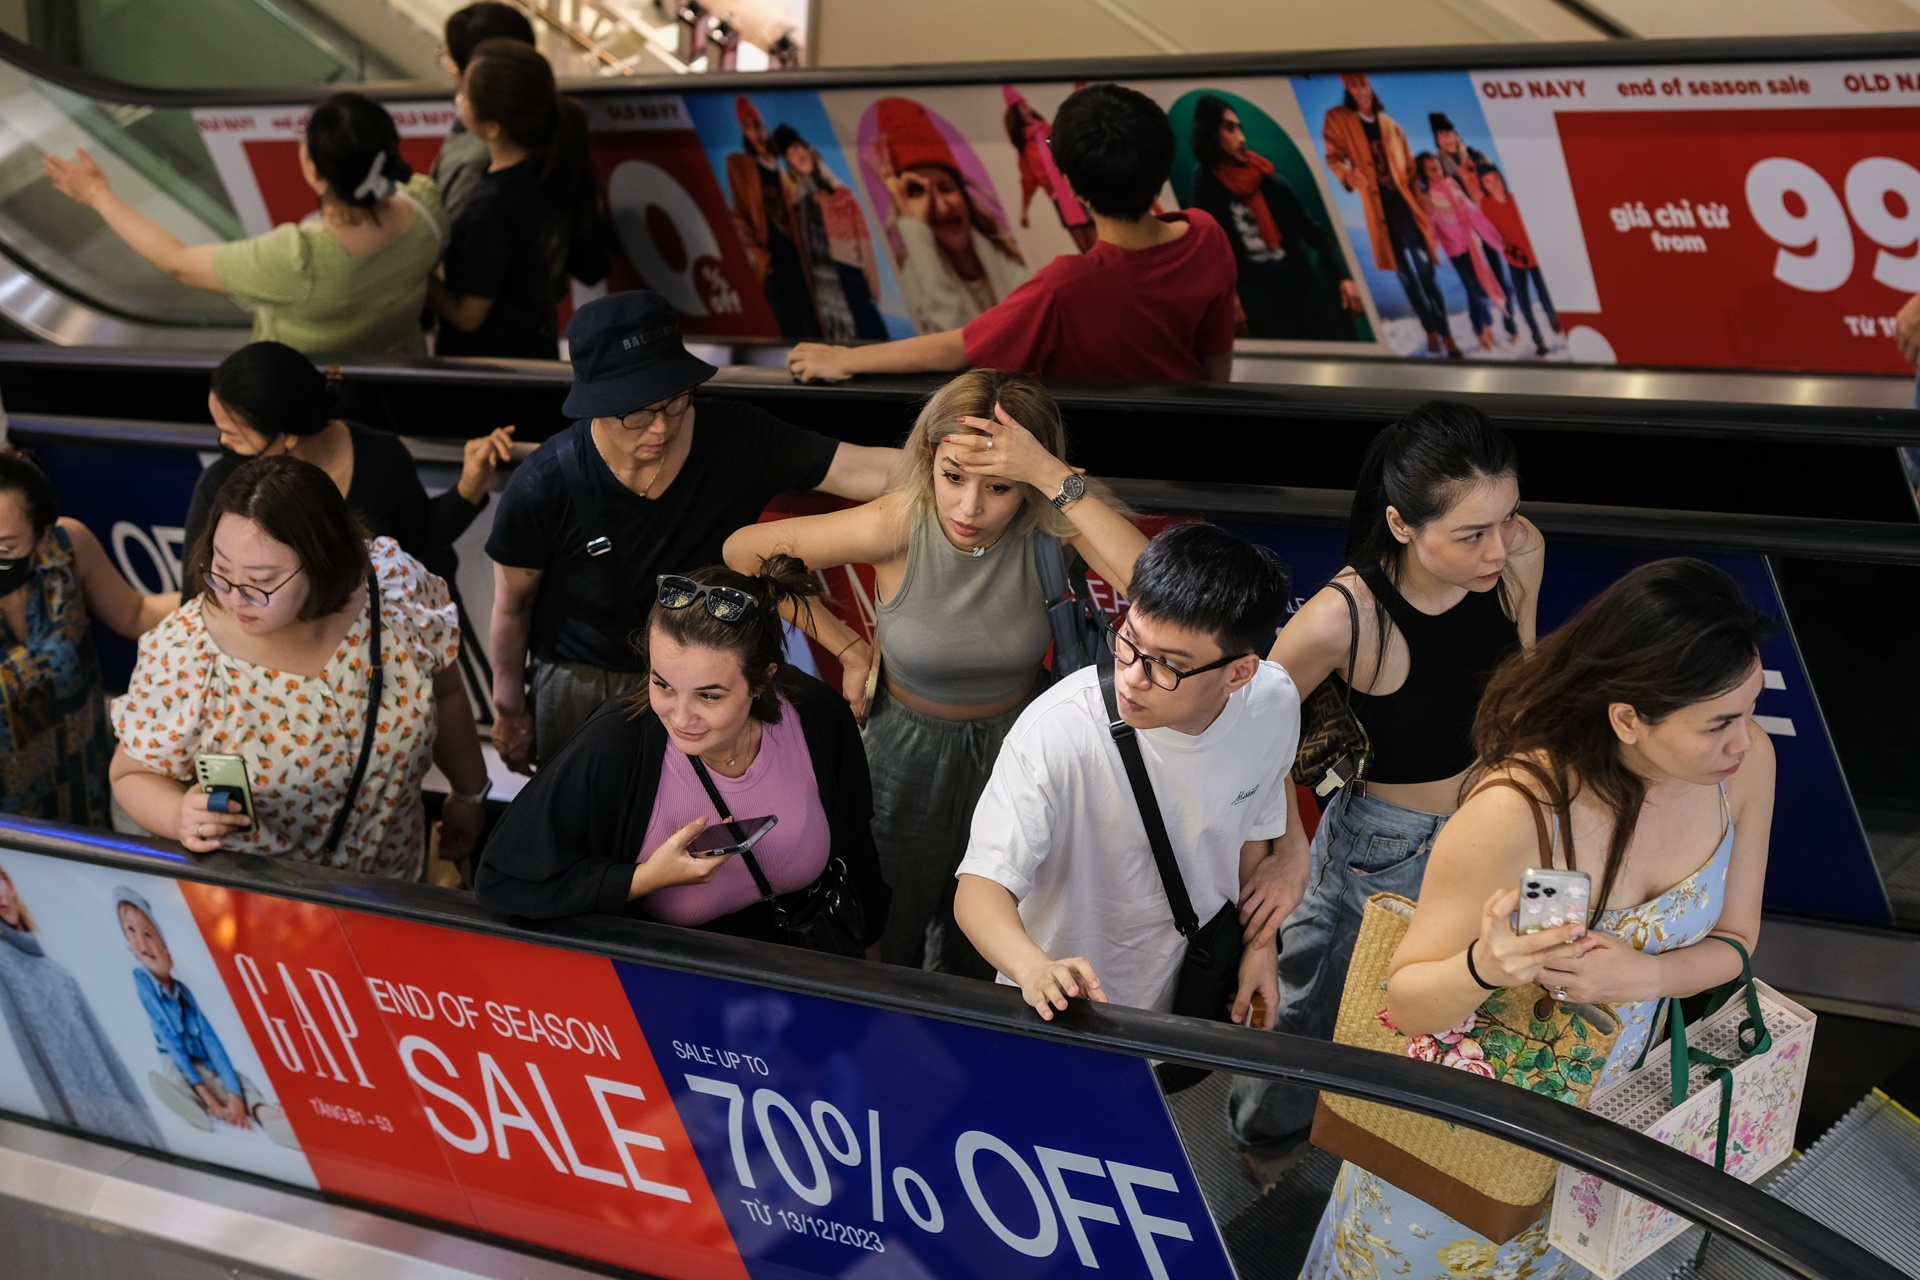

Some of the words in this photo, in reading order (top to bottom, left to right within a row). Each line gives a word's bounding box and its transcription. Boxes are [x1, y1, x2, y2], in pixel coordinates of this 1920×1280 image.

[1482, 80, 1524, 99] OLD
[1527, 80, 1586, 98] NAVY
[1618, 76, 1656, 96] end
[1661, 77, 1682, 95] of
[1686, 79, 1763, 96] season
[1767, 74, 1811, 95] sale
[1843, 73, 1892, 93] OLD
[1609, 201, 1653, 232] giá
[1744, 156, 1920, 294] 99
[1650, 230, 1708, 253] from
[234, 953, 376, 1089] GAP
[366, 976, 435, 1020] END
[437, 991, 479, 1030] OF
[485, 1000, 621, 1061] SEASON
[672, 1040, 718, 1066] SALE
[715, 1048, 741, 1070] UP
[741, 1054, 770, 1077] TO
[399, 1034, 692, 1204] SALE
[684, 1073, 945, 1234] 70%
[955, 1130, 1195, 1280] OFF
[740, 1198, 773, 1227] TỪ
[777, 1209, 886, 1254] 13/12/2023
